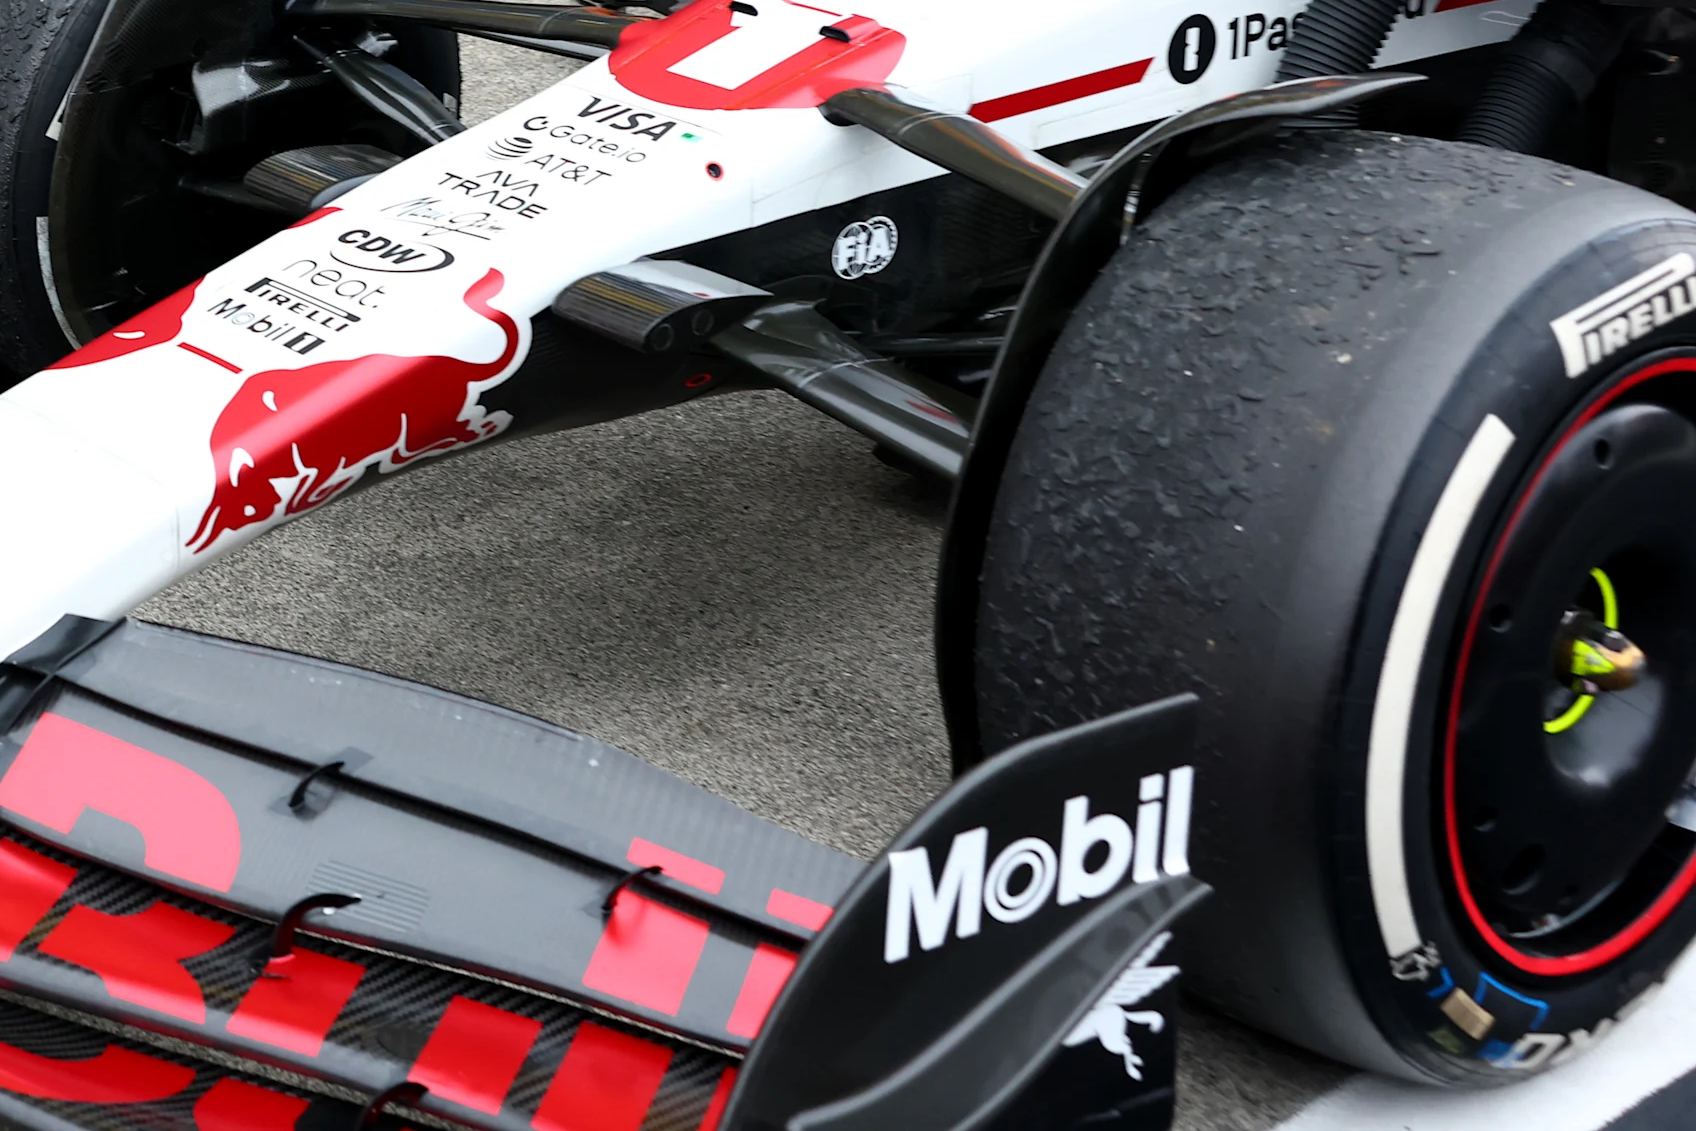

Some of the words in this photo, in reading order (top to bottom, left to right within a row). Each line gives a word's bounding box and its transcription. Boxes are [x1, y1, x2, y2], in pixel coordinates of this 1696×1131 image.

[576, 95, 678, 142] VISA
[549, 124, 647, 164] Gate.io
[475, 169, 541, 198] AVA
[524, 153, 613, 186] AT&T
[437, 172, 549, 220] TRADE
[337, 229, 427, 266] CDW
[206, 297, 296, 342] Mobil
[244, 277, 363, 333] PIRELLI
[884, 764, 1194, 965] Mobil
